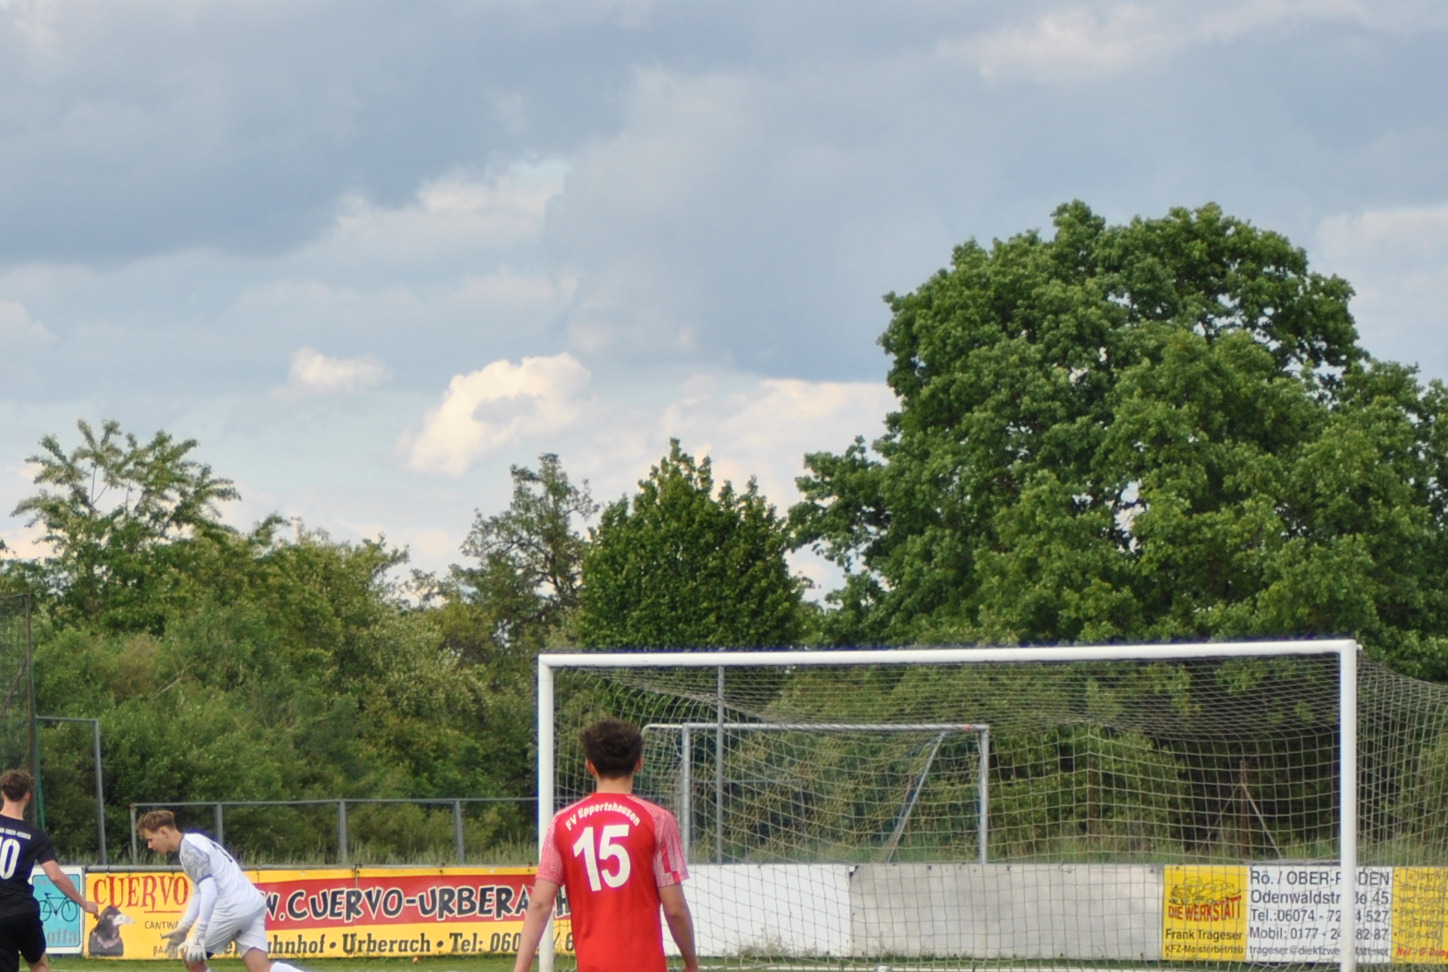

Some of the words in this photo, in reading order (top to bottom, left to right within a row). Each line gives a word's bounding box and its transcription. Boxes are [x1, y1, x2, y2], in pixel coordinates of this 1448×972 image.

[565, 816, 577, 831] FV
[578, 803, 640, 826] Eppertshausen
[573, 824, 631, 892] 15
[1250, 871, 1273, 885] Rö.
[1286, 871, 1389, 886] OBER-RDEN
[93, 875, 189, 910] CUERVO
[1251, 890, 1367, 904] Odenwaldstre
[1372, 891, 1389, 904] 45
[1168, 906, 1183, 920] DIE
[1185, 895, 1242, 921] WERKSTATT
[1366, 910, 1389, 922] 527
[1166, 929, 1194, 939] Frank
[1198, 930, 1242, 942] Trageser
[1250, 927, 1286, 940] Mobil:
[1290, 928, 1319, 940] 0177
[1374, 928, 1389, 940] 87
[267, 934, 326, 954] hnhof
[342, 932, 431, 953] Urberach
[449, 932, 483, 953] Tel:
[490, 932, 522, 952] 060
